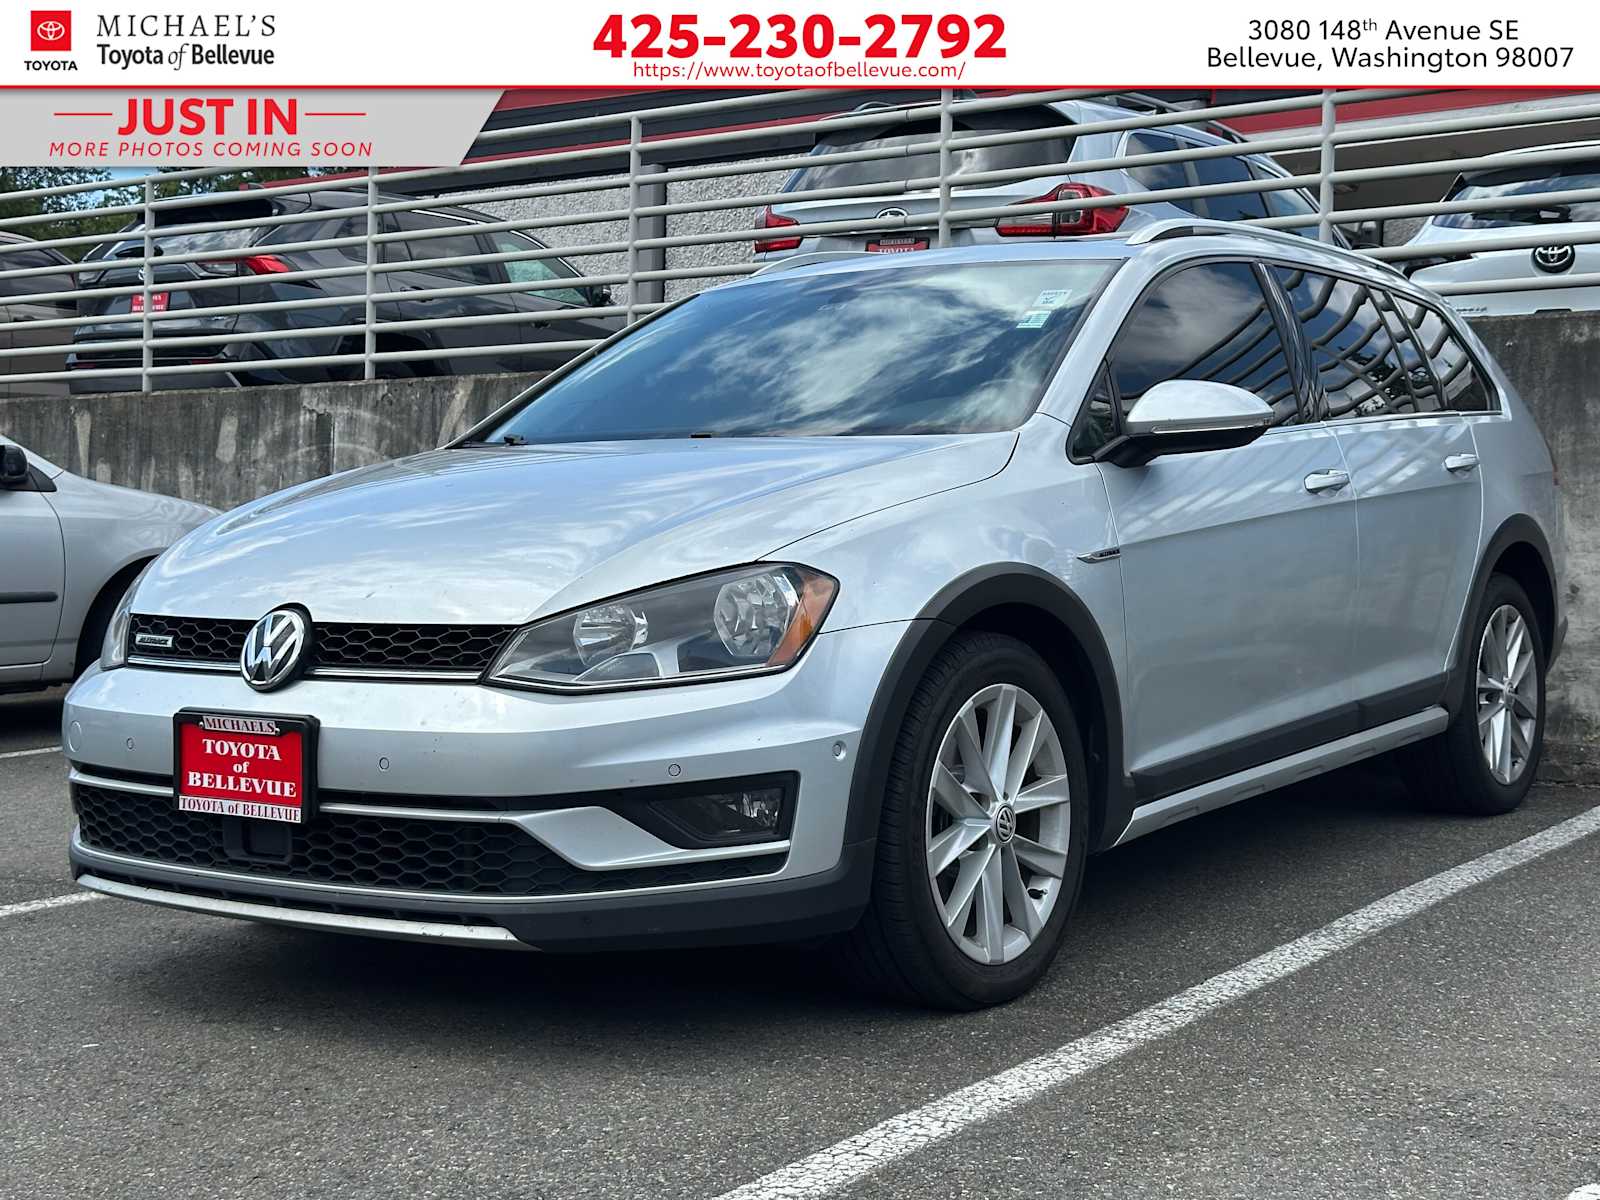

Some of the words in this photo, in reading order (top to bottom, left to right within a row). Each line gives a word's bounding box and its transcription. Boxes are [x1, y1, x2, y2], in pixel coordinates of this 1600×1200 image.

[204, 717, 275, 733] MICHAELS
[202, 738, 281, 760] TOYOTA
[232, 761, 250, 774] of
[188, 771, 296, 797] BELLEVUE
[180, 797, 225, 813] TOYOTA
[228, 803, 240, 815] of
[243, 803, 300, 822] BELLEVUE
